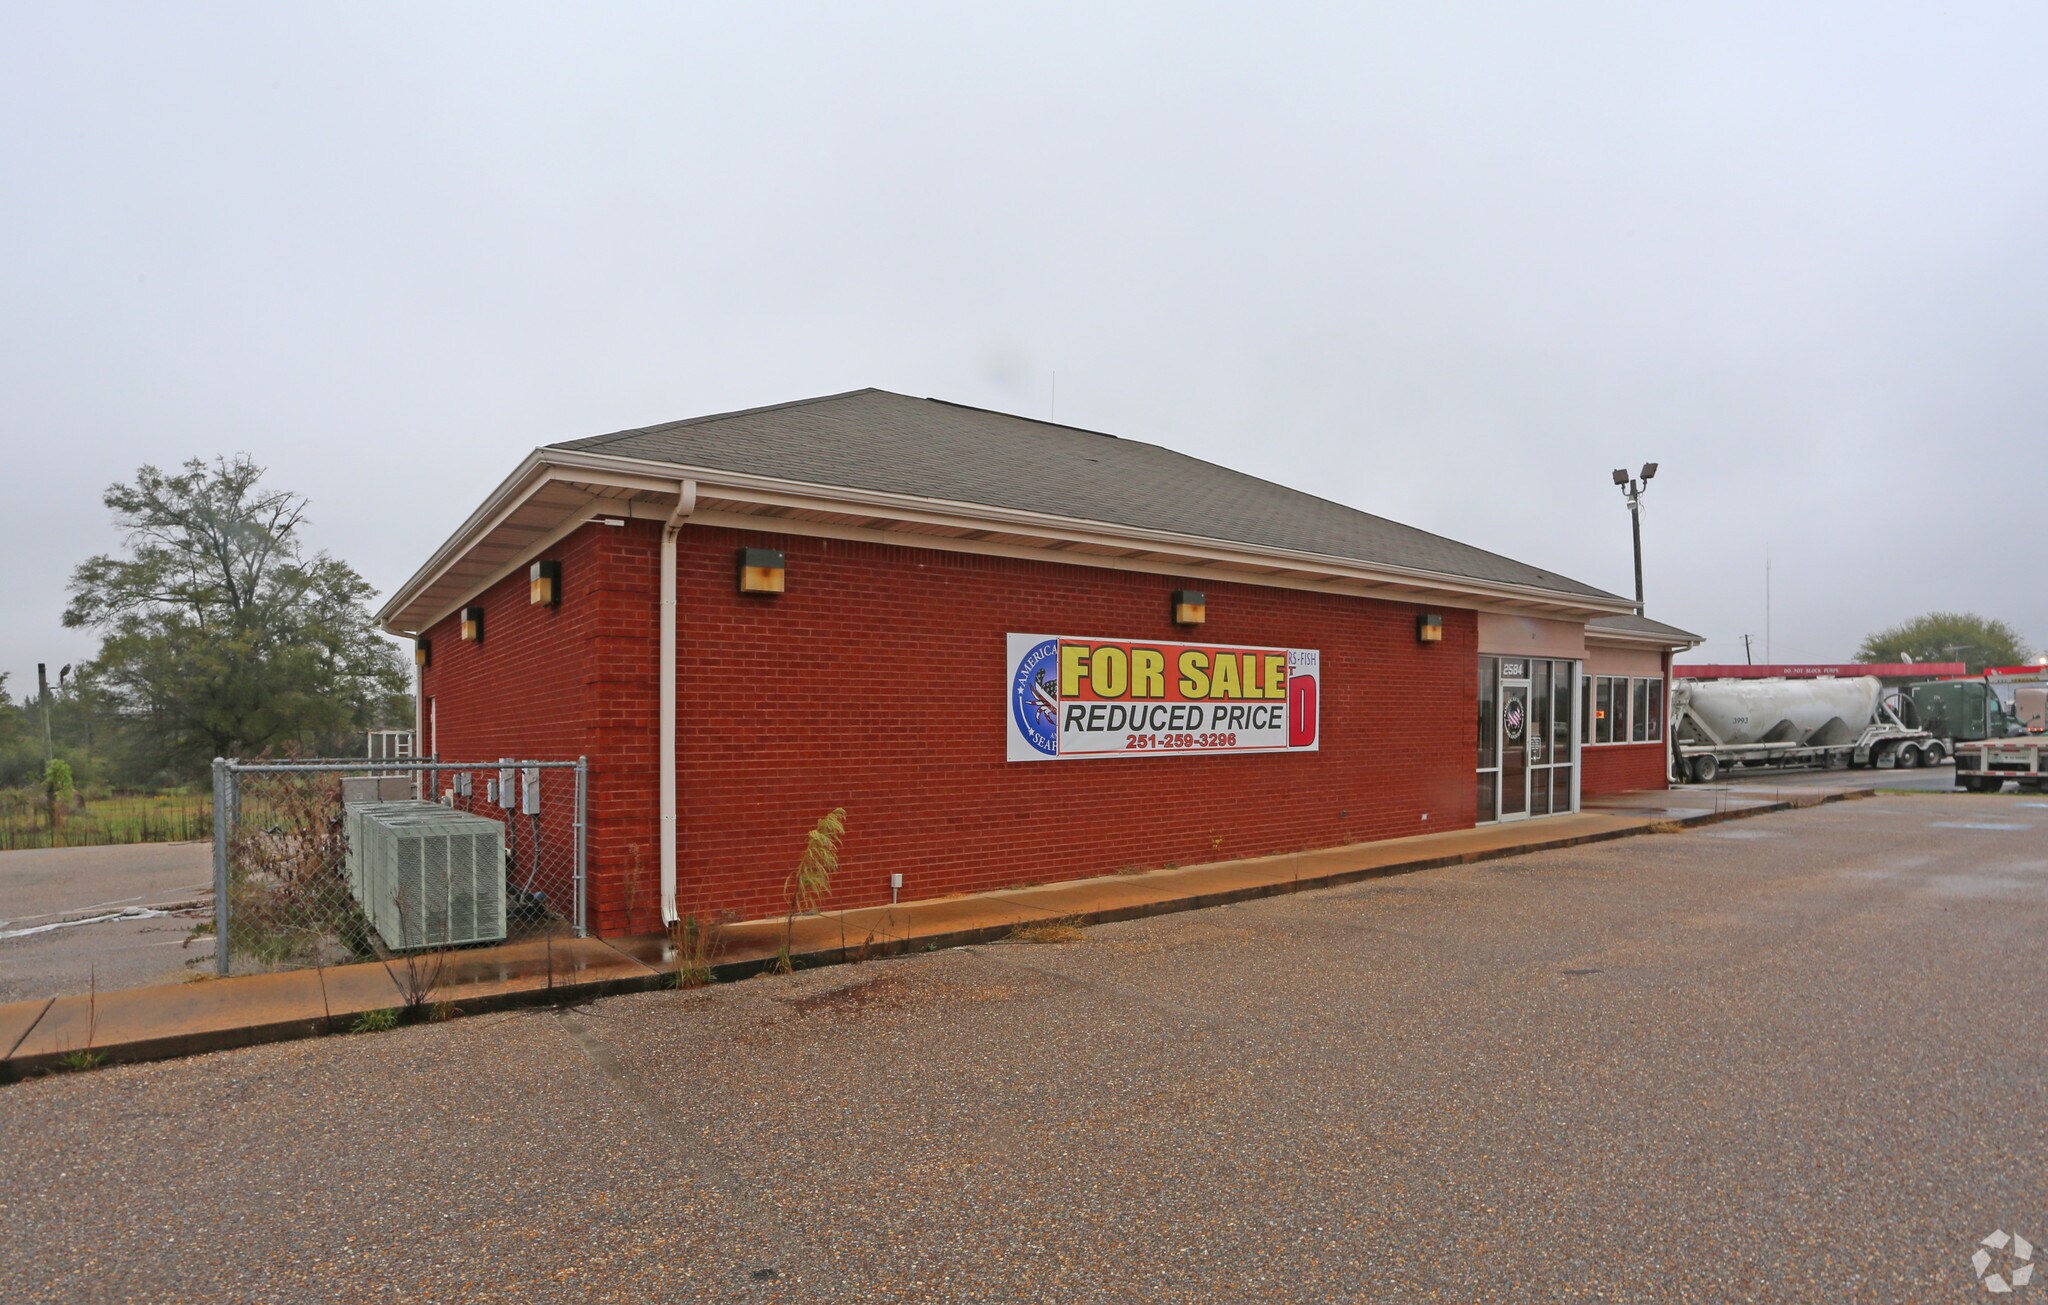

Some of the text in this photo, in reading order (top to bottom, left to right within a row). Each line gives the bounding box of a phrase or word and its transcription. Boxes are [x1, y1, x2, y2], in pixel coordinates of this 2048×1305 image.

[1060, 644, 1286, 700] FOR SALE
[1503, 663, 1523, 675] 2584
[1064, 704, 1284, 732] REDUCED PRICE
[1126, 733, 1237, 749] 251-259-3296
